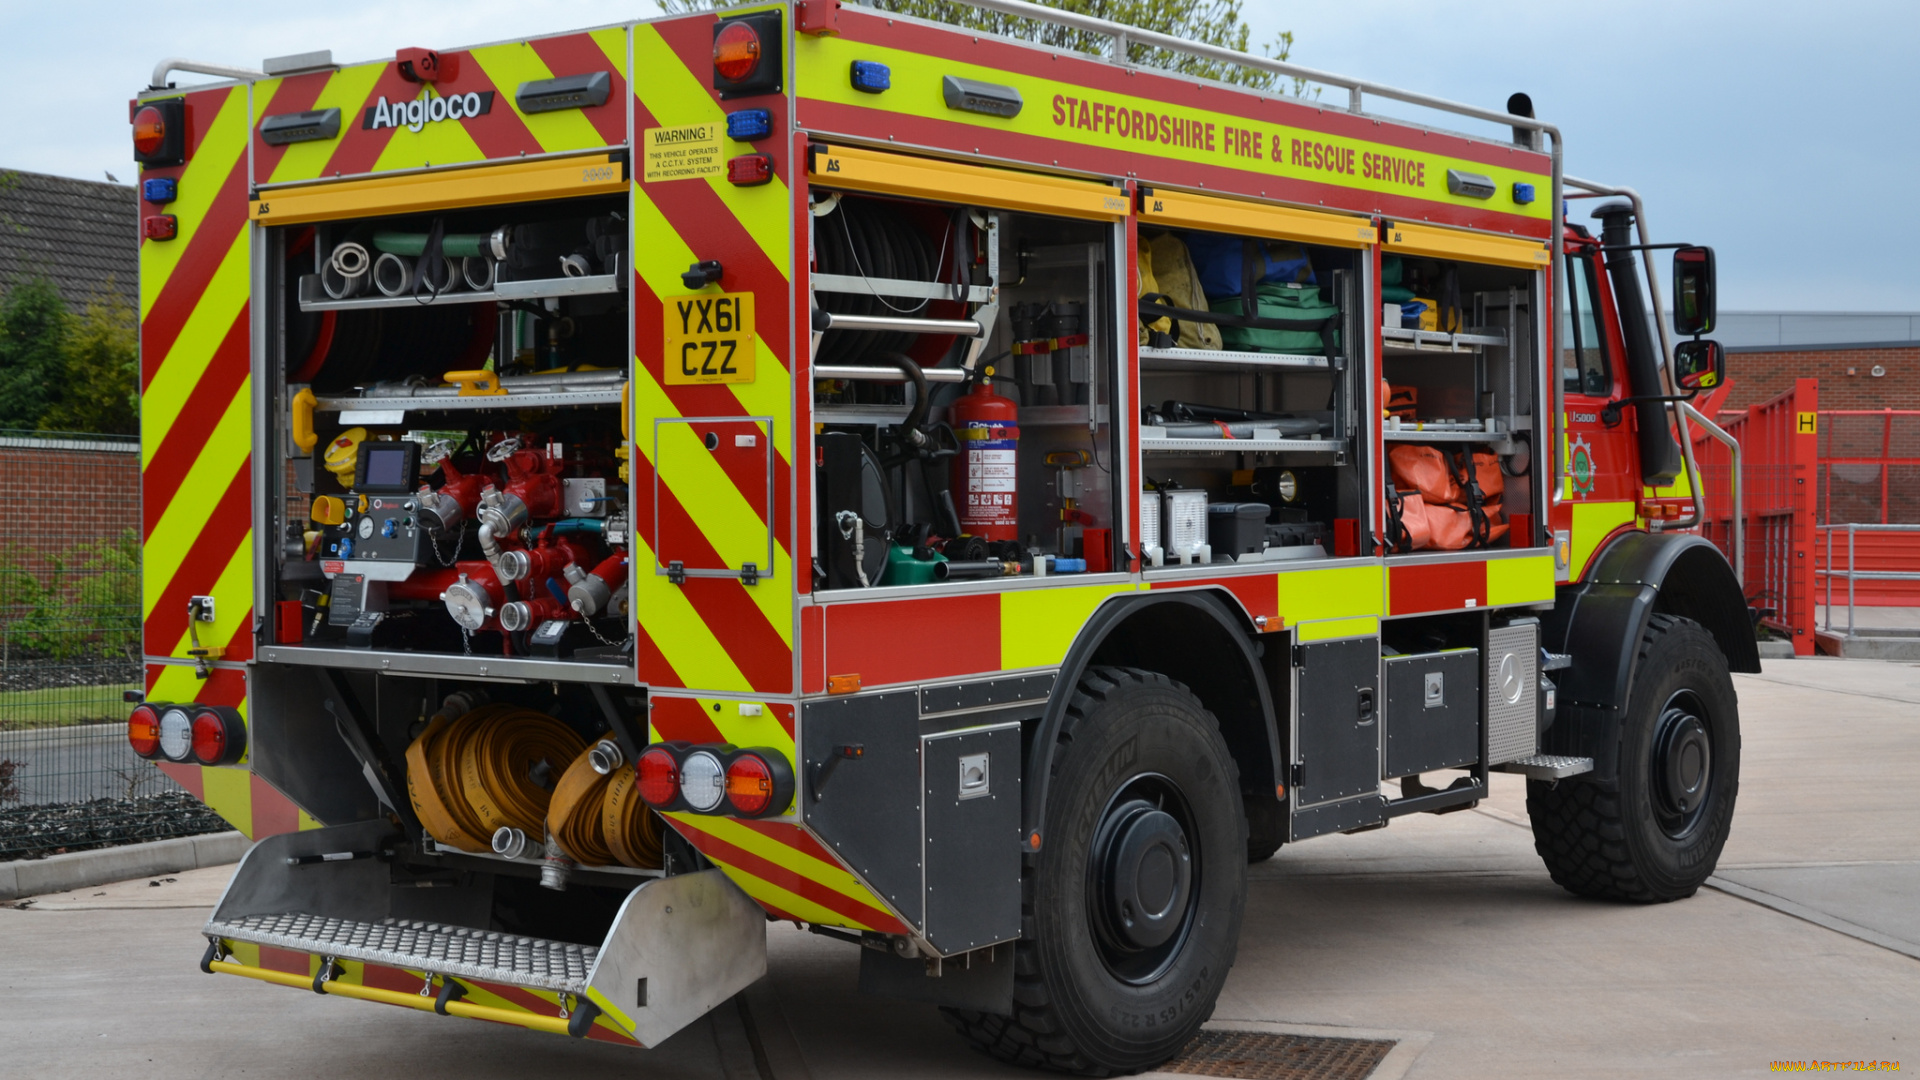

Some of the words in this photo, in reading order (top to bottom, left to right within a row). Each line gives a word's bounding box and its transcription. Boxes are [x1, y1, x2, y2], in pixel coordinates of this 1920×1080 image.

[372, 90, 481, 133] Angloco
[654, 127, 706, 143] WARNING
[1052, 94, 1215, 152] STAFFORDSHIRE
[1224, 126, 1263, 160] FIRE
[1271, 134, 1283, 163] &
[1291, 138, 1355, 175] RESCUE
[1362, 151, 1426, 188] SERVICE
[663, 149, 687, 158] VEHICLE
[688, 147, 719, 156] OPERATES
[687, 157, 713, 165] SYSTEM
[582, 166, 614, 182] 2000
[647, 171, 661, 179] WITH
[662, 168, 696, 177] RECORDING
[696, 166, 721, 174] FACILITY
[677, 297, 741, 334] YX61
[682, 340, 737, 376] CZZ
[1799, 414, 1814, 431] H
[1680, 795, 1727, 867] MICHELIN
